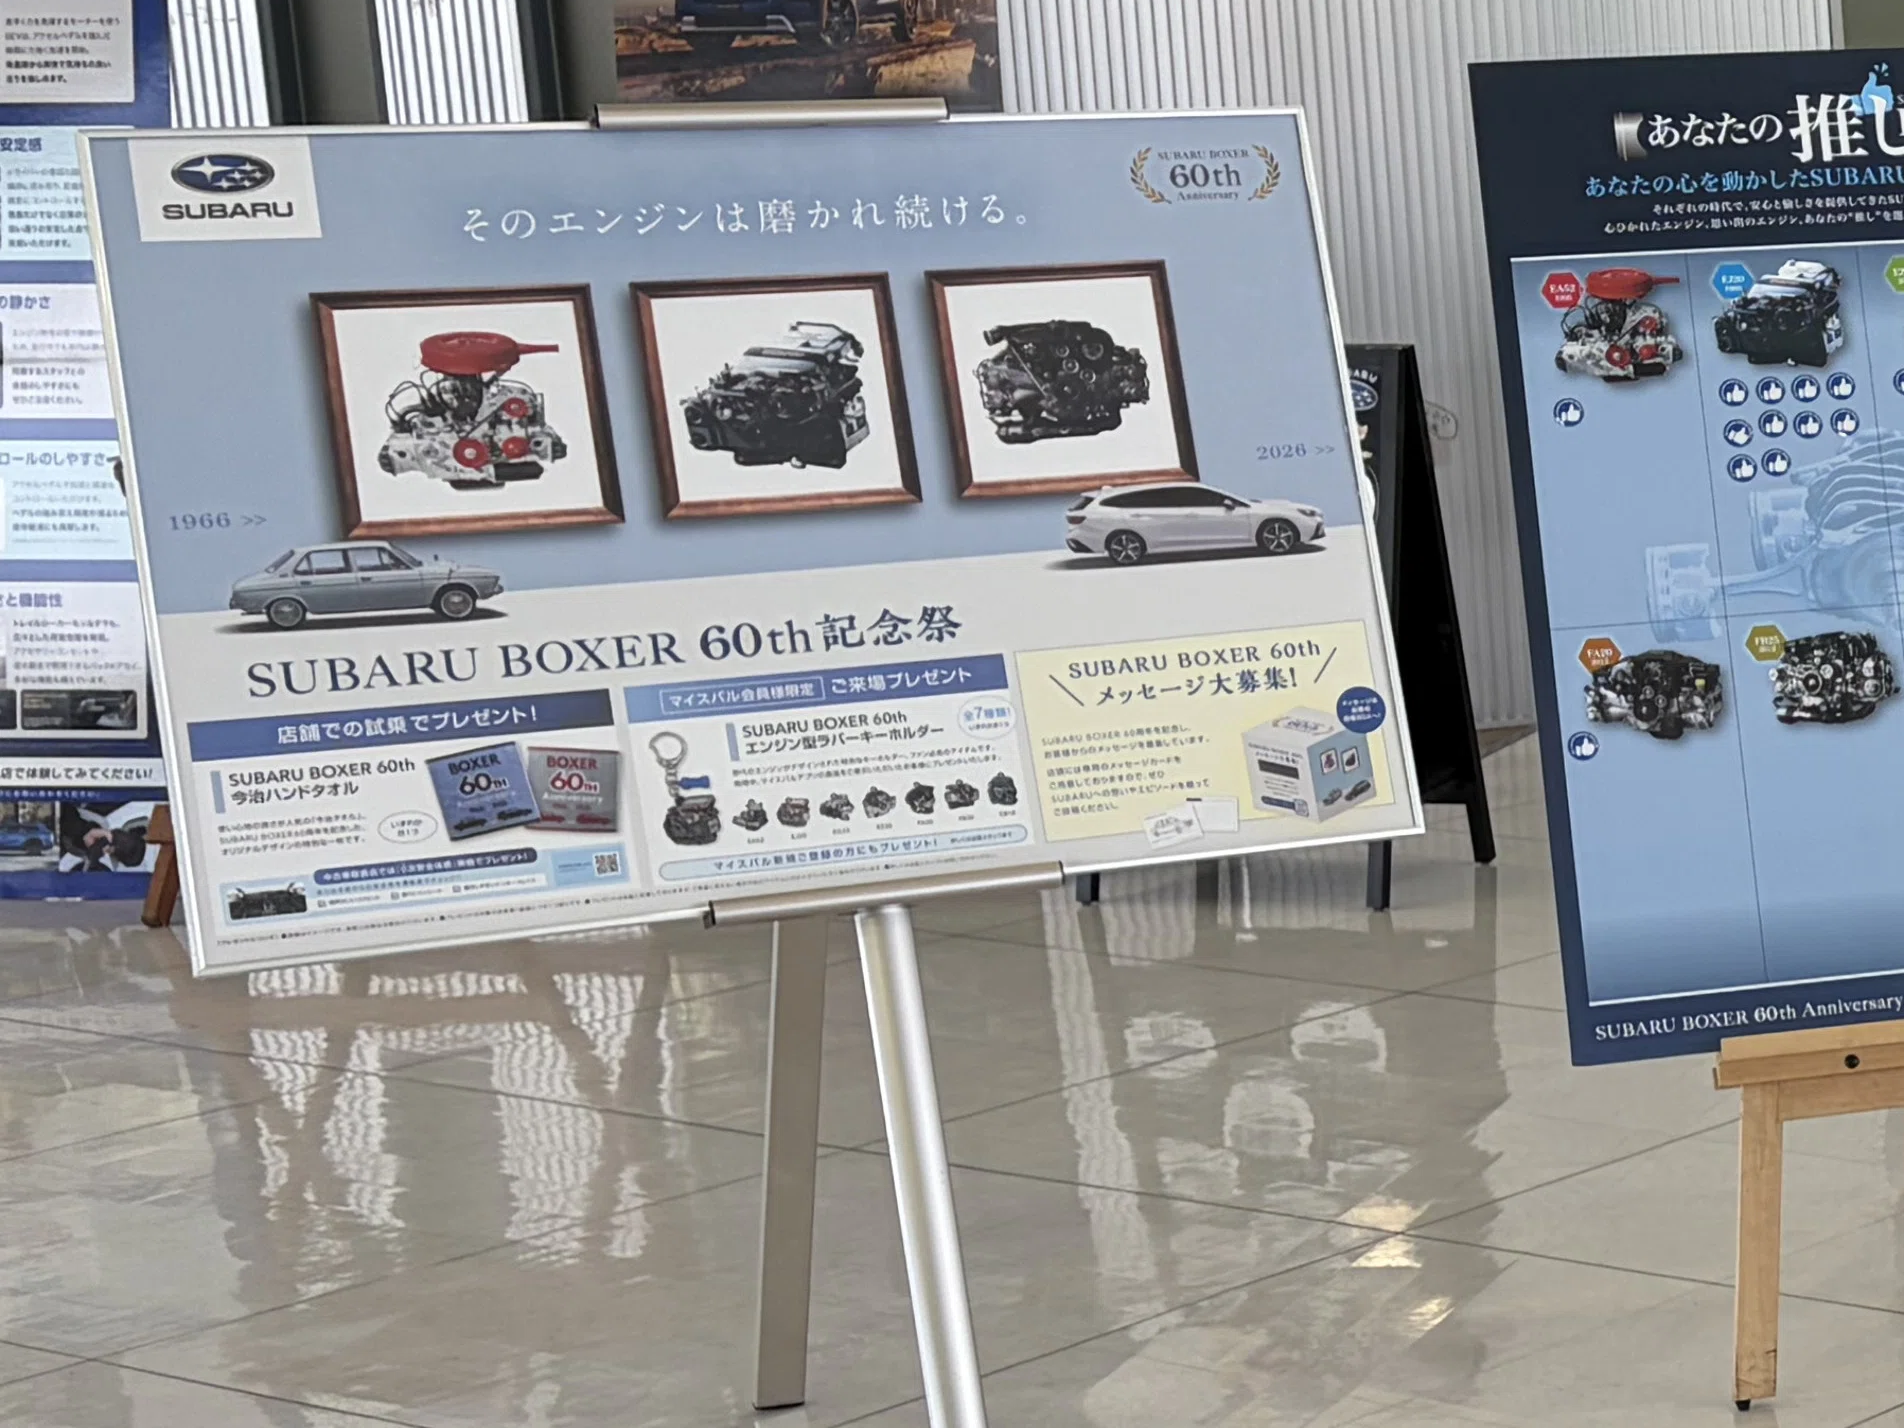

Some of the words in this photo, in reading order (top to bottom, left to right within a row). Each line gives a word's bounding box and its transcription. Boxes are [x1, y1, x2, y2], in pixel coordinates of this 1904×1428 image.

[1157, 149, 1207, 161] SUBARU
[1209, 148, 1250, 160] BOXER
[1168, 163, 1242, 189] 60th
[1176, 189, 1240, 203] Anniversary
[161, 200, 294, 221] SUBARU
[461, 193, 1028, 241] そのエンジンは磨かれ続ける。
[1549, 283, 1576, 293] EA52
[1256, 444, 1307, 461] 2026
[169, 512, 231, 531] 1966
[247, 647, 479, 698] SUBARU
[498, 631, 686, 679] BOXER
[1068, 654, 1168, 679] SUBARU
[1178, 645, 1262, 670] BOXER
[1270, 639, 1321, 660] 60th
[669, 682, 815, 709] マイスバル会員様限定
[831, 667, 973, 695] ご来場プレゼント
[1097, 667, 1298, 707] メッセージ大募集!
[277, 705, 538, 745] 店舗での試乗でプレゼント!
[742, 721, 809, 738] SUBARU
[813, 714, 870, 732] BOXER
[873, 710, 908, 726] 60th
[745, 726, 945, 755] エンジン型ラバーキーホルダー
[229, 767, 304, 788] SUBARU
[308, 762, 372, 781] BOXER
[376, 759, 416, 774] 60th
[448, 753, 503, 776] BOXER
[546, 756, 598, 771] BOXER
[230, 783, 360, 806] 今治ハンドタオル
[1595, 1015, 1676, 1042] SUBARU
[1682, 1007, 1750, 1032] BOXER
[1754, 1001, 1796, 1024] 60th
[1802, 992, 1904, 1020] Anniversary
